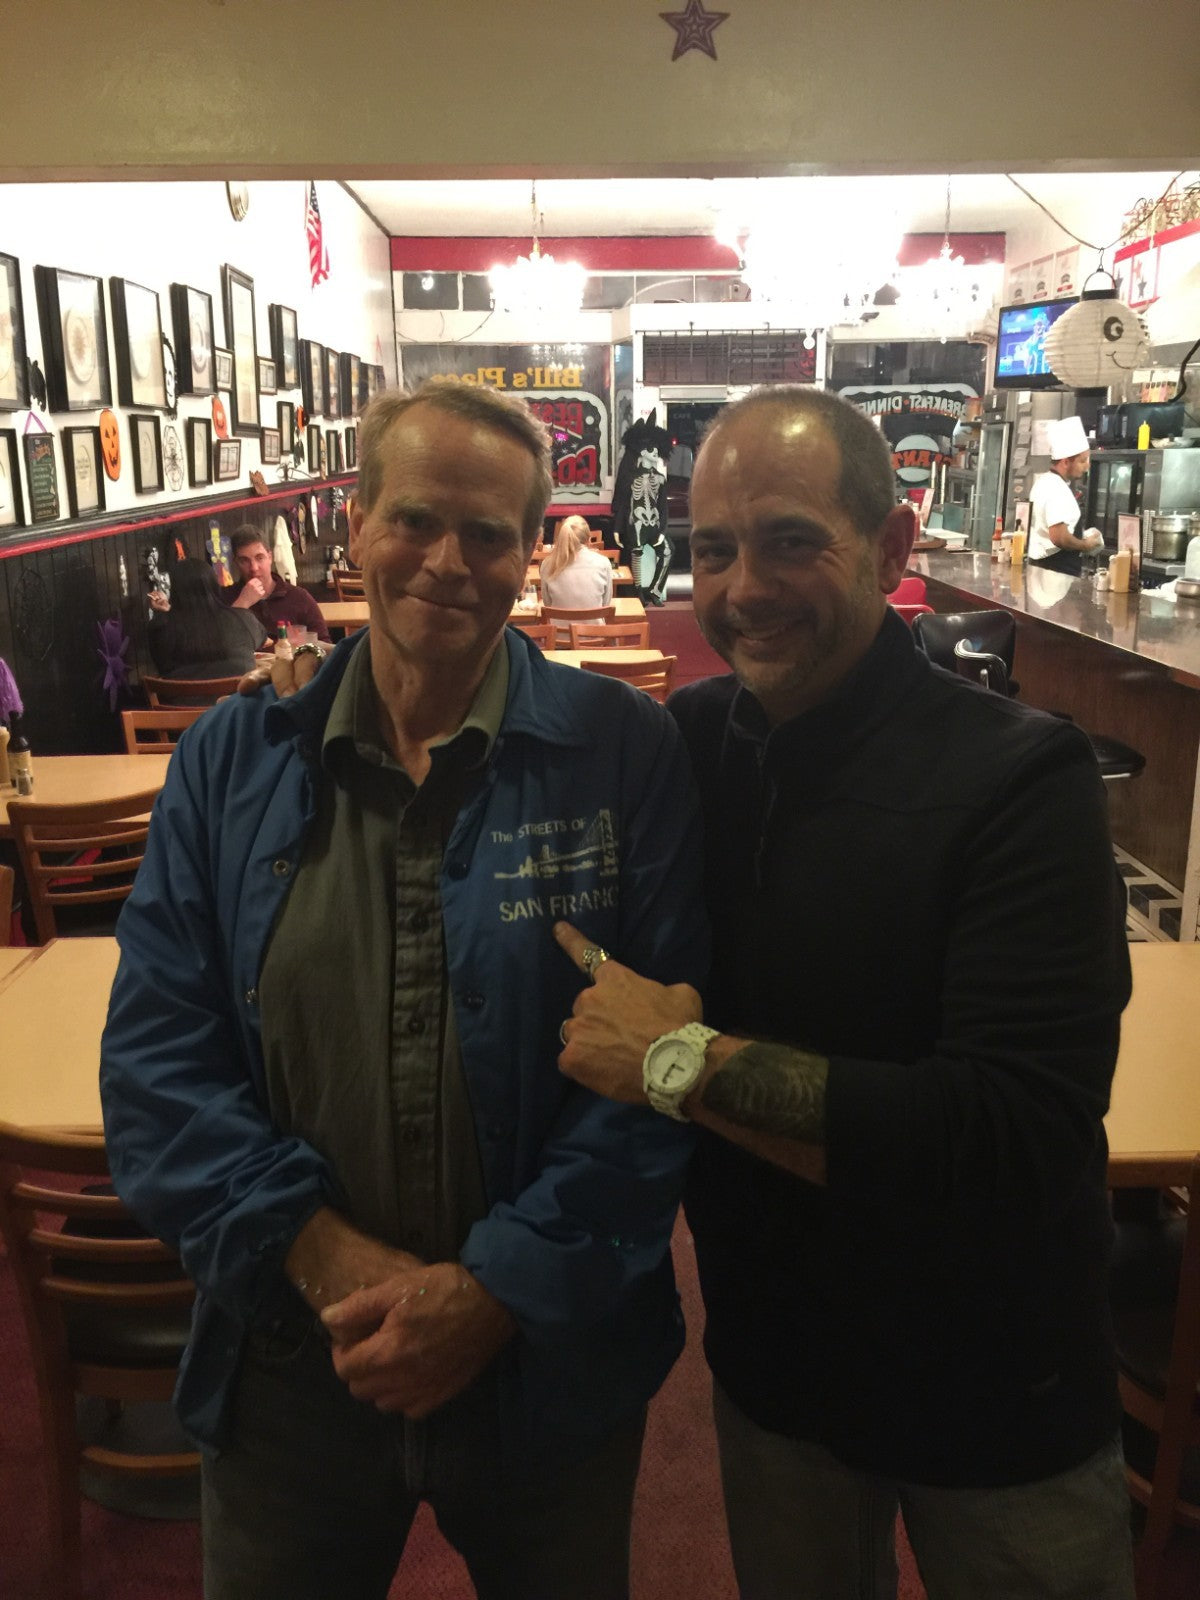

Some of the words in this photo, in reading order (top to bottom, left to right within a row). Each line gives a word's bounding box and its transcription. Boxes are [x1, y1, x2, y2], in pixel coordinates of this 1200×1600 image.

[491, 831, 513, 843] The
[518, 820, 567, 838] STREETS
[571, 817, 586, 830] OF
[500, 898, 543, 922] SAN
